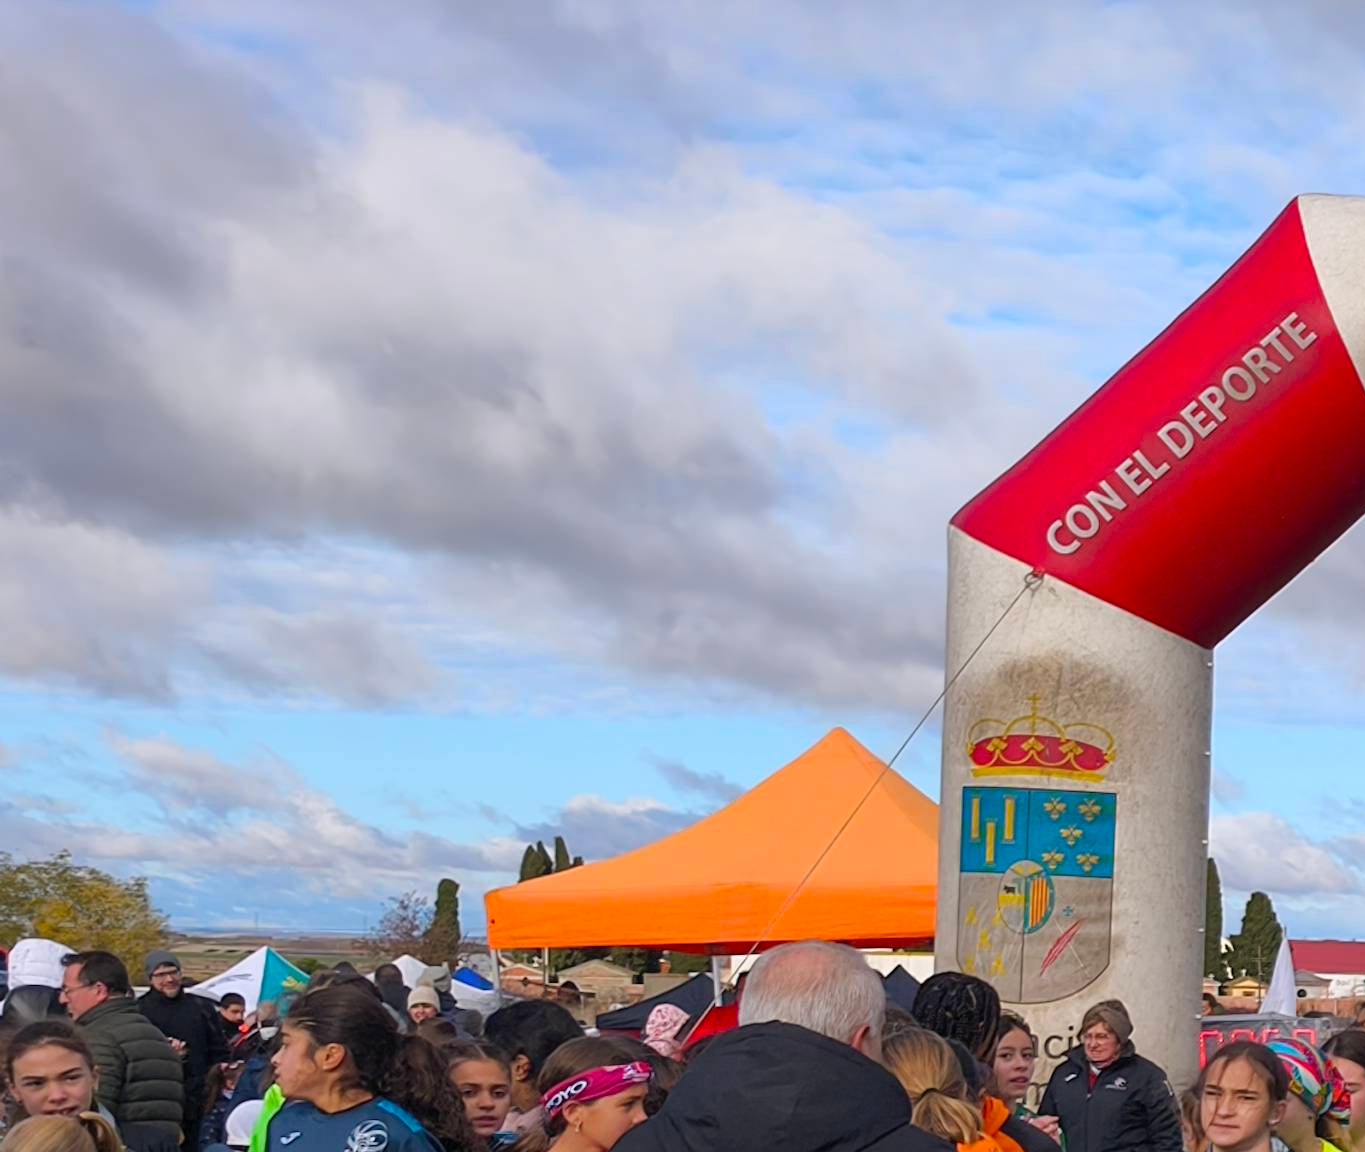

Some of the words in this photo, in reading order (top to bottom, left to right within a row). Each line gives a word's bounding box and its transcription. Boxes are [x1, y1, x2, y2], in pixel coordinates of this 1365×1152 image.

[1046, 479, 1128, 555] CON
[1114, 449, 1171, 496] EL
[1156, 311, 1318, 460] DEPORTE
